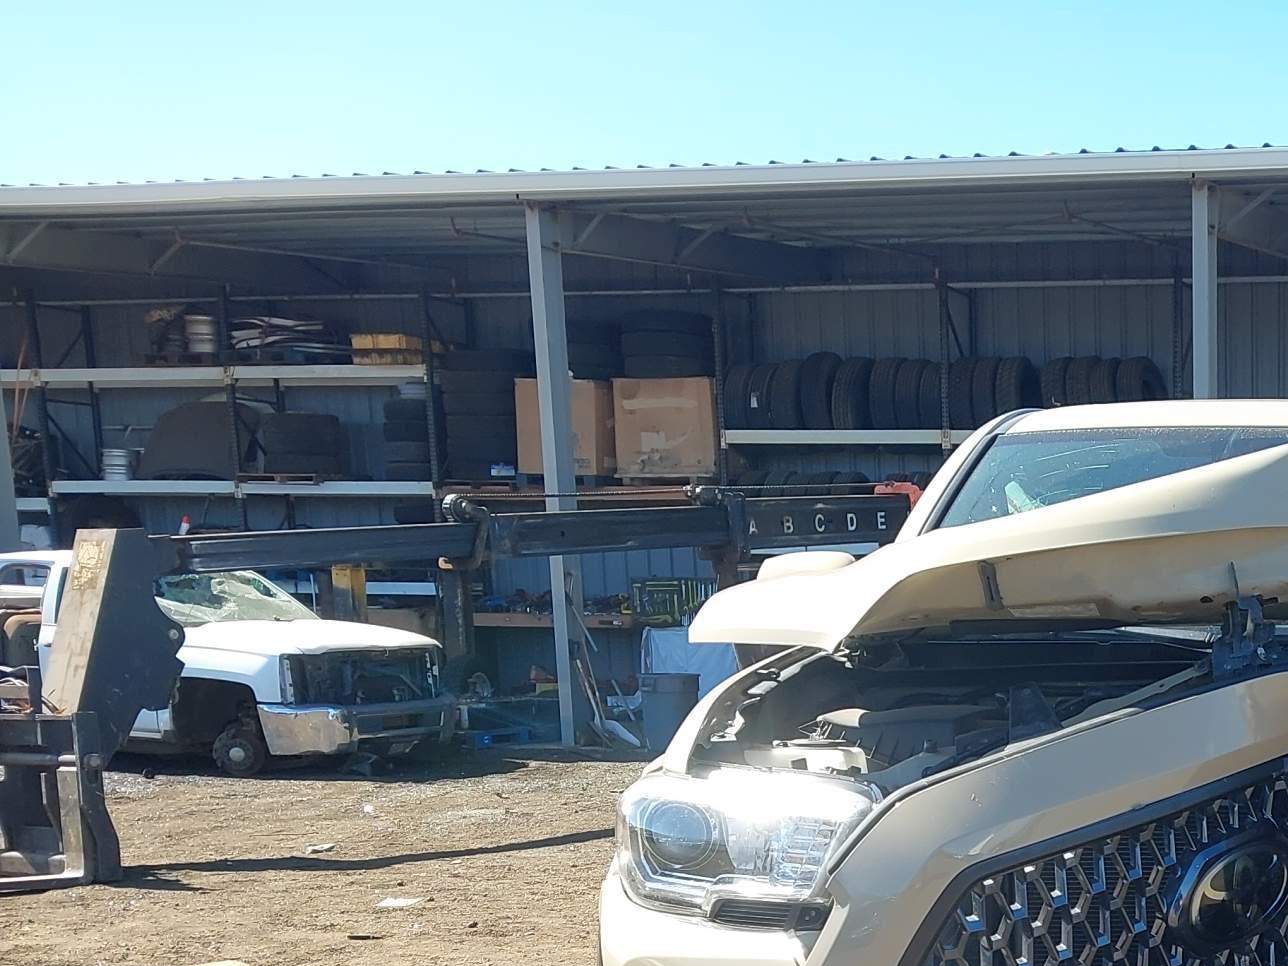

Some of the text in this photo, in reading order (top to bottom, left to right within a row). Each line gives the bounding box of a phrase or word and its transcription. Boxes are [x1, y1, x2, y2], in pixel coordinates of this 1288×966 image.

[749, 511, 887, 534] A B C D E
